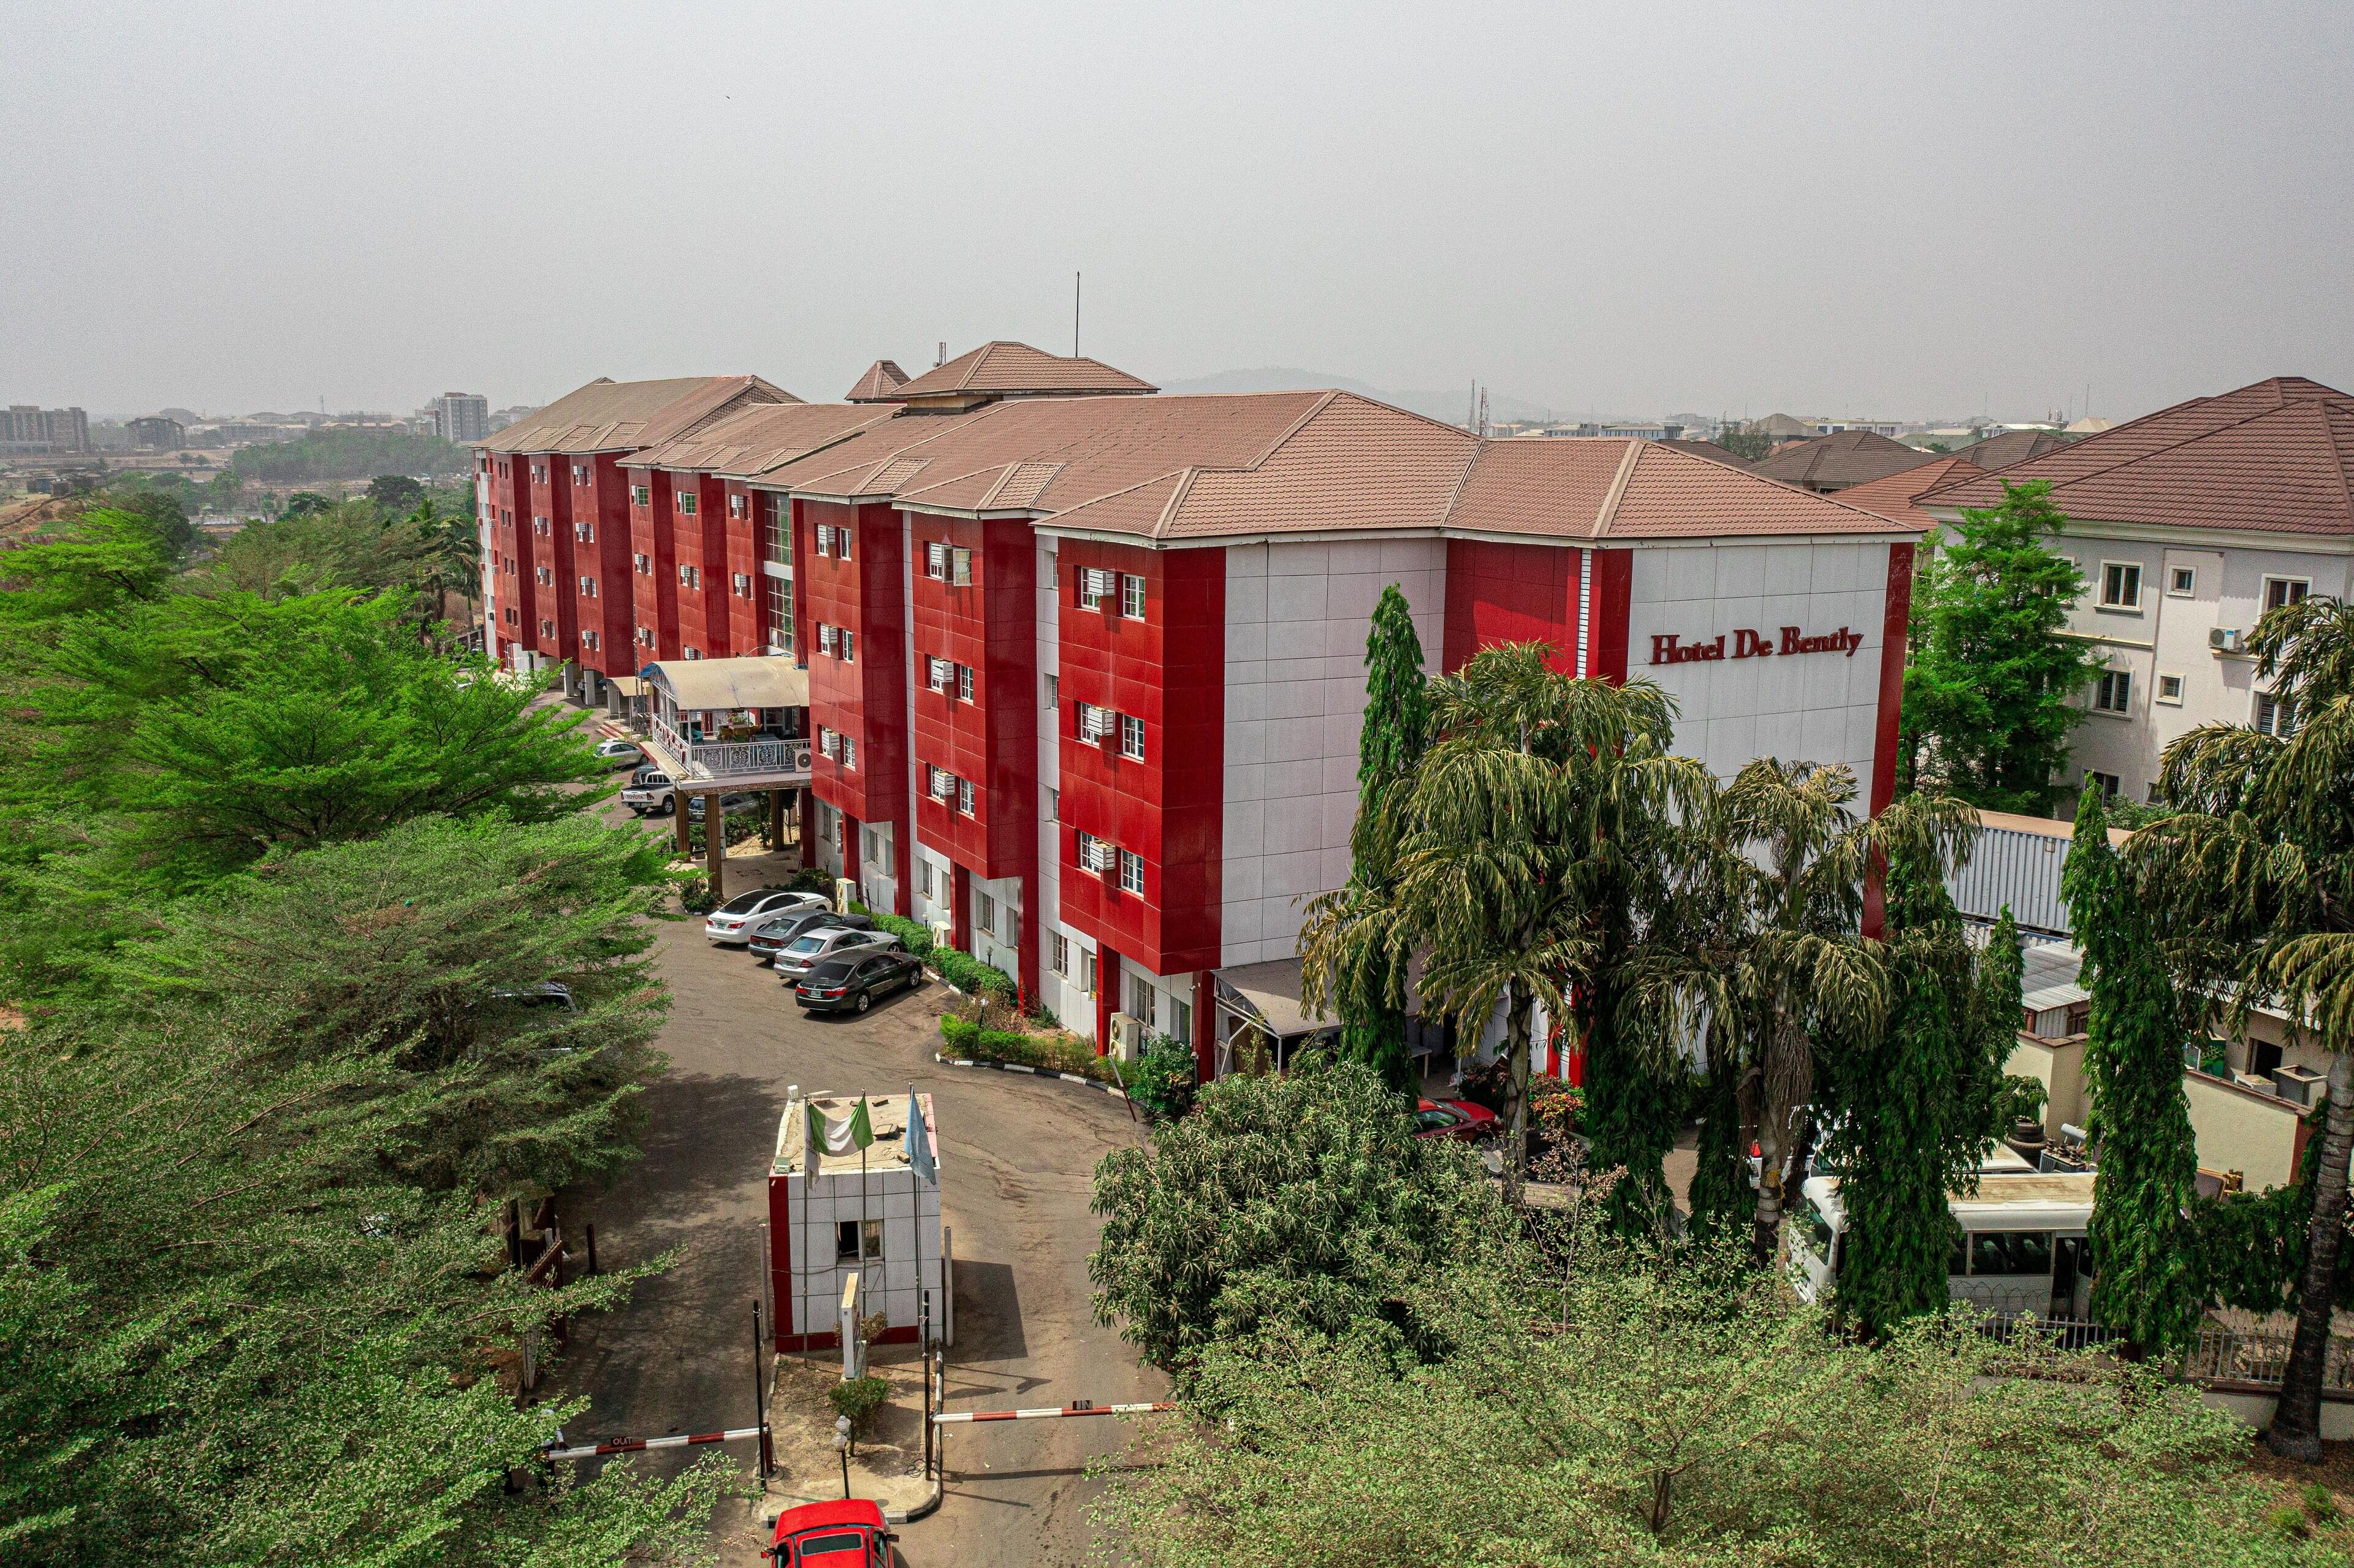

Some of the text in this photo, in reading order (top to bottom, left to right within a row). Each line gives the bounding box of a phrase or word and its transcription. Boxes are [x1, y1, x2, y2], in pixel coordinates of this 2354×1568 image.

[1649, 626, 1864, 665] Hotel De Bently
[1076, 1400, 1092, 1410] IN
[613, 1436, 632, 1445] OUT
